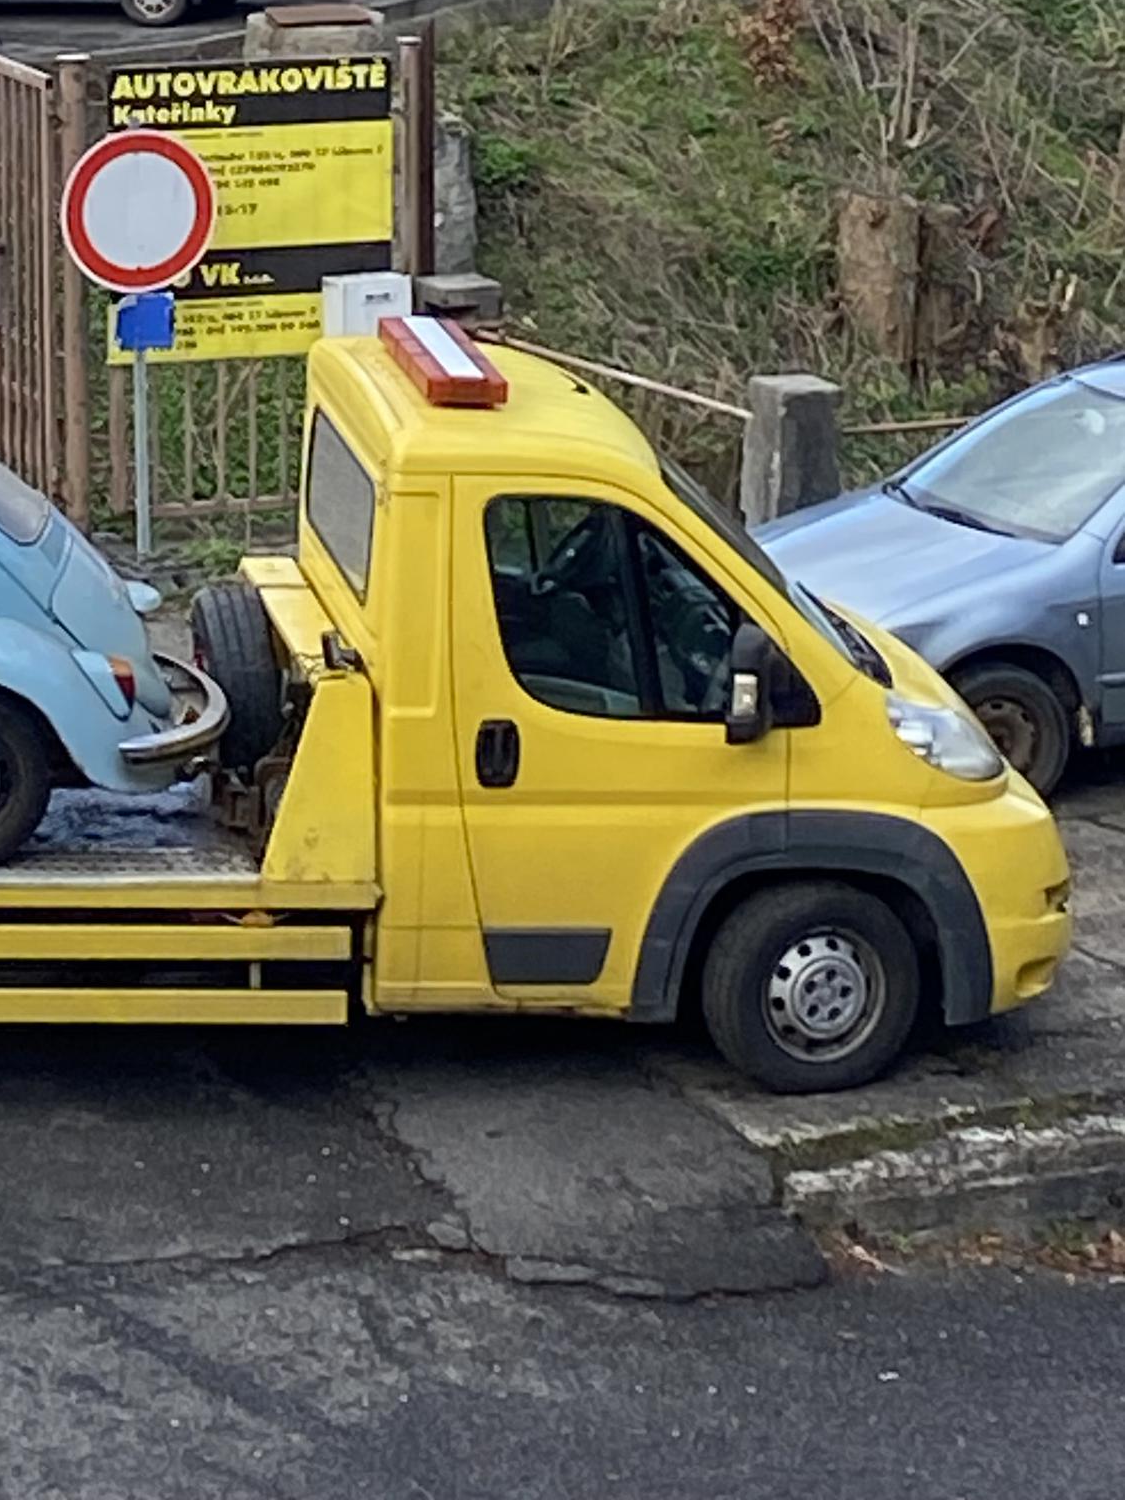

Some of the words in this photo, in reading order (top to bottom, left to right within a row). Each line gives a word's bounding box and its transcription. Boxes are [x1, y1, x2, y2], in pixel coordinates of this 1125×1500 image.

[111, 58, 387, 100] AUTOVRAKOVIŠTĚ
[113, 101, 236, 125] Kateřinky
[199, 262, 241, 287] VK
